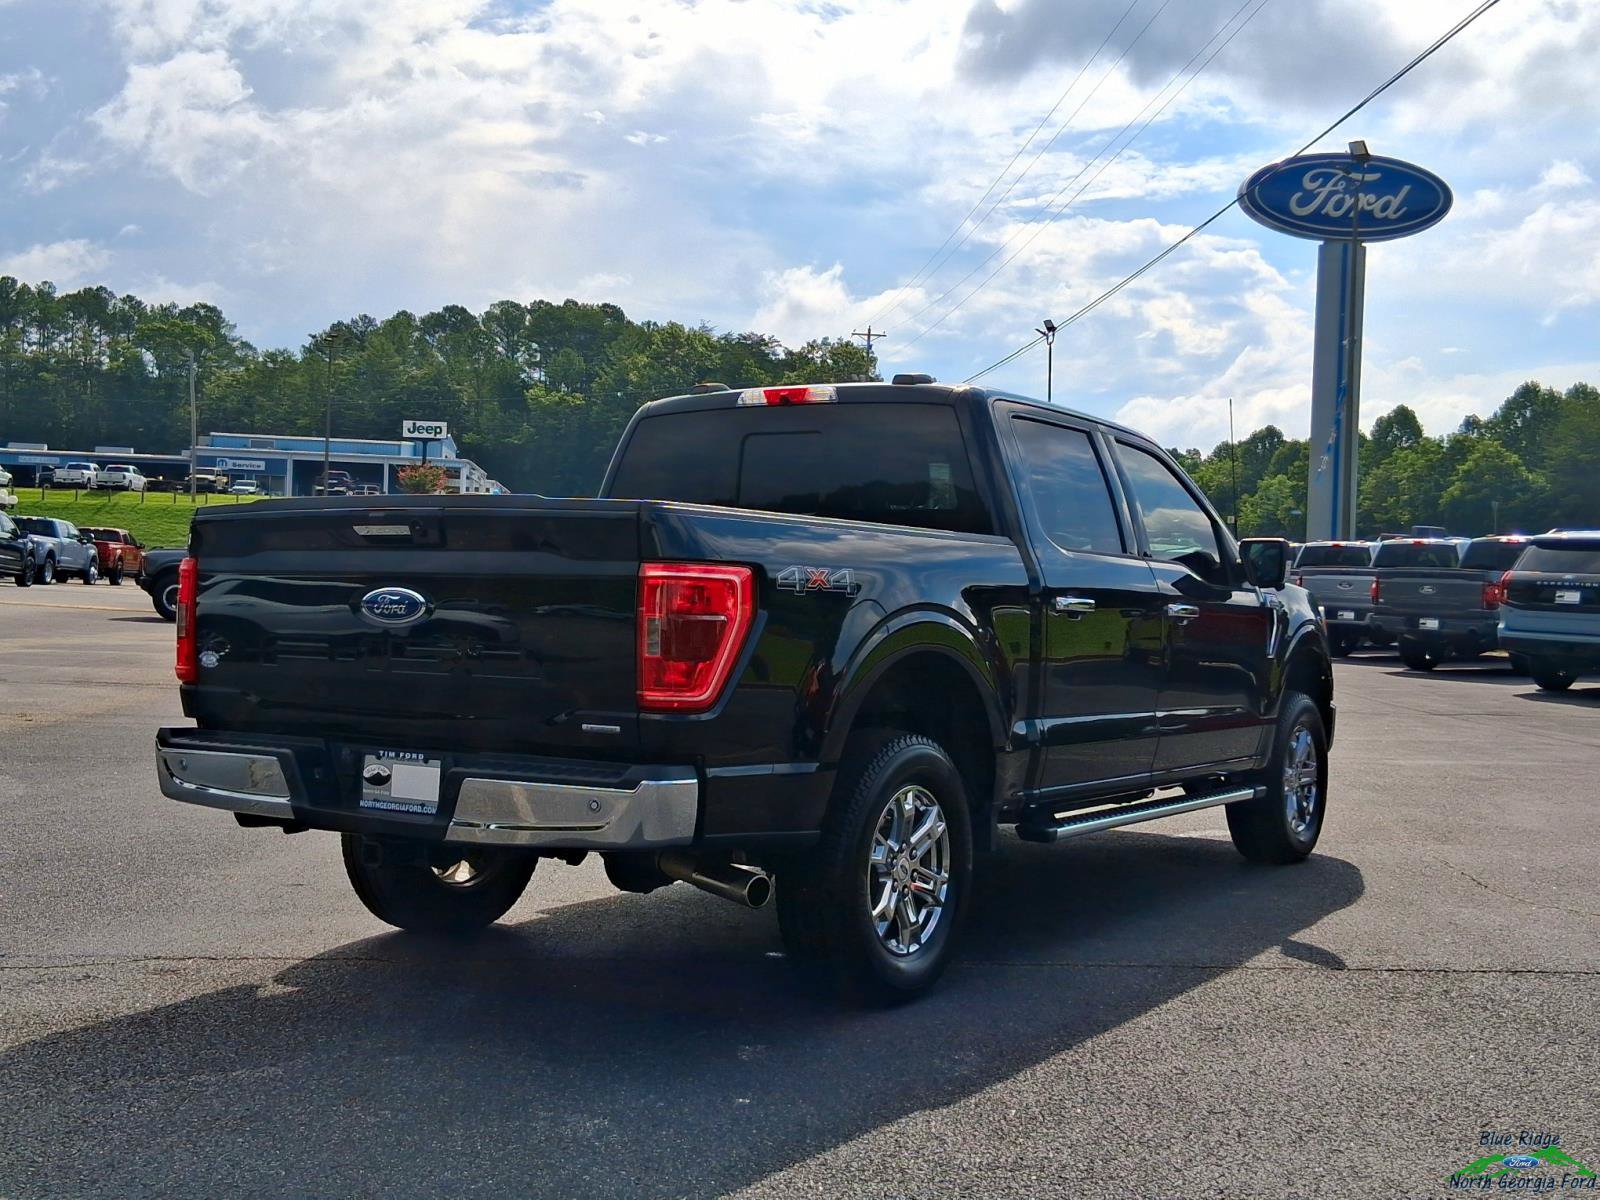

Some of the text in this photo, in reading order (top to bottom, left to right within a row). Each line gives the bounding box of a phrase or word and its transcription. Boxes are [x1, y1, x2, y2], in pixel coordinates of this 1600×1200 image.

[1289, 168, 1411, 220] Ford
[407, 422, 442, 437] Jeep
[232, 461, 262, 469] Service
[373, 594, 409, 614] Ford
[378, 750, 424, 760] TIM FORD
